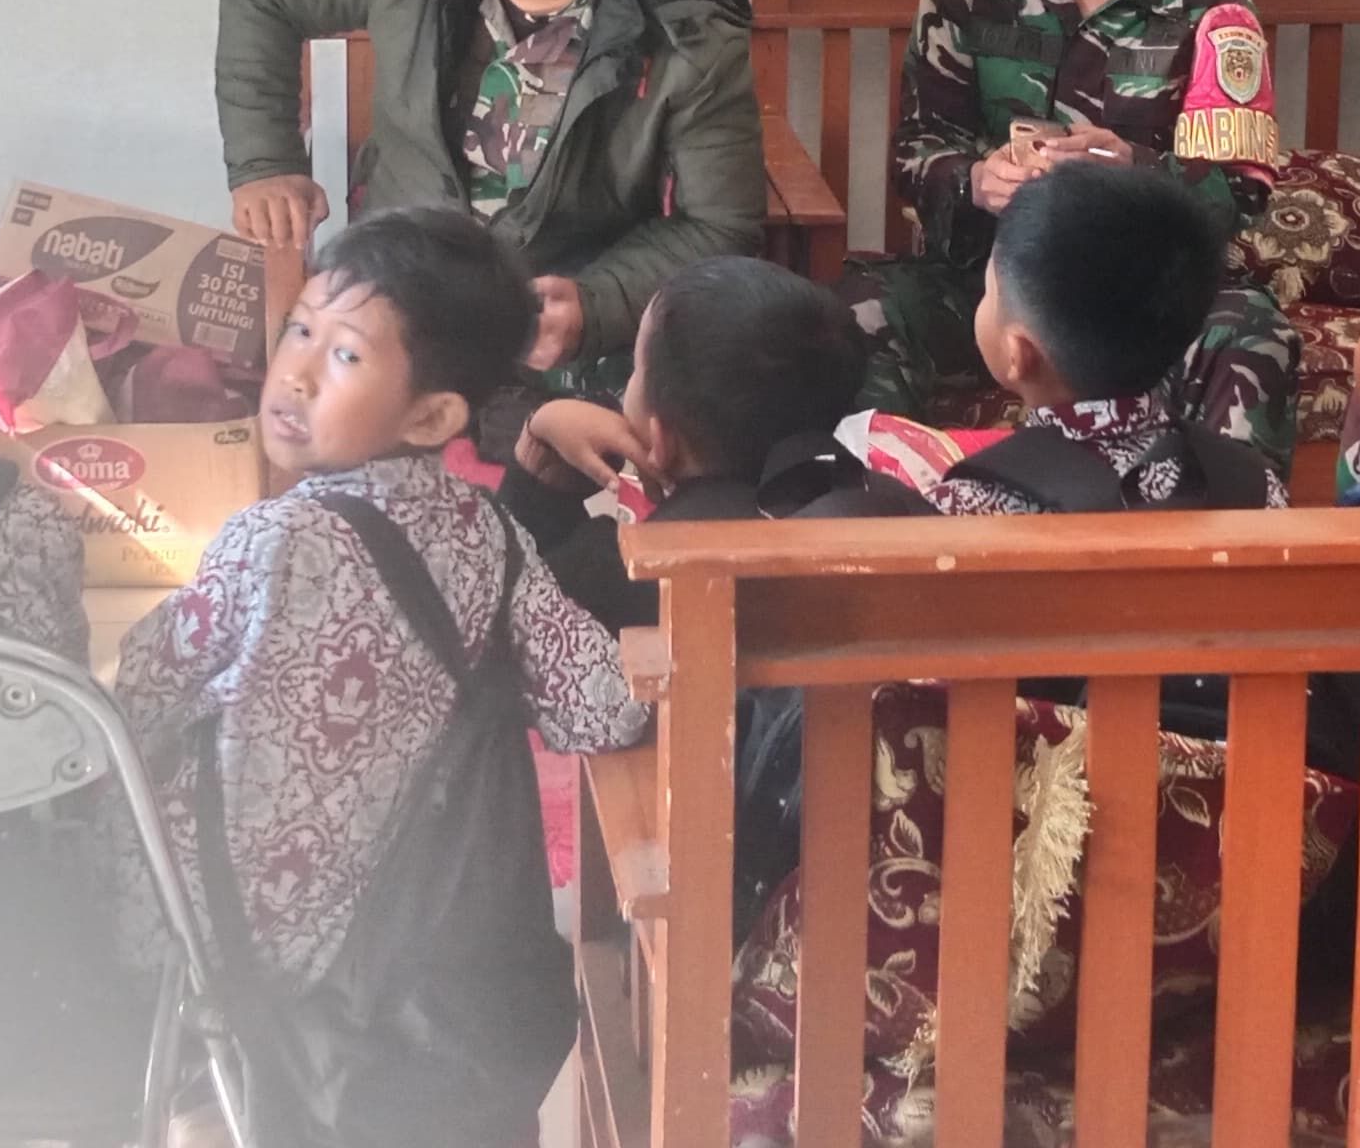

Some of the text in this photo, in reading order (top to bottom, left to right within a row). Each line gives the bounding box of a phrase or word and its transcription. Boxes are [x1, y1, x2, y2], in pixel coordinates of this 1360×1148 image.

[42, 229, 125, 270] nabati
[221, 262, 245, 282] ISI
[198, 273, 260, 302] 30 PCS
[201, 290, 248, 313] EXTRA
[187, 302, 254, 330] UNTUNG!
[50, 455, 130, 480] Roma
